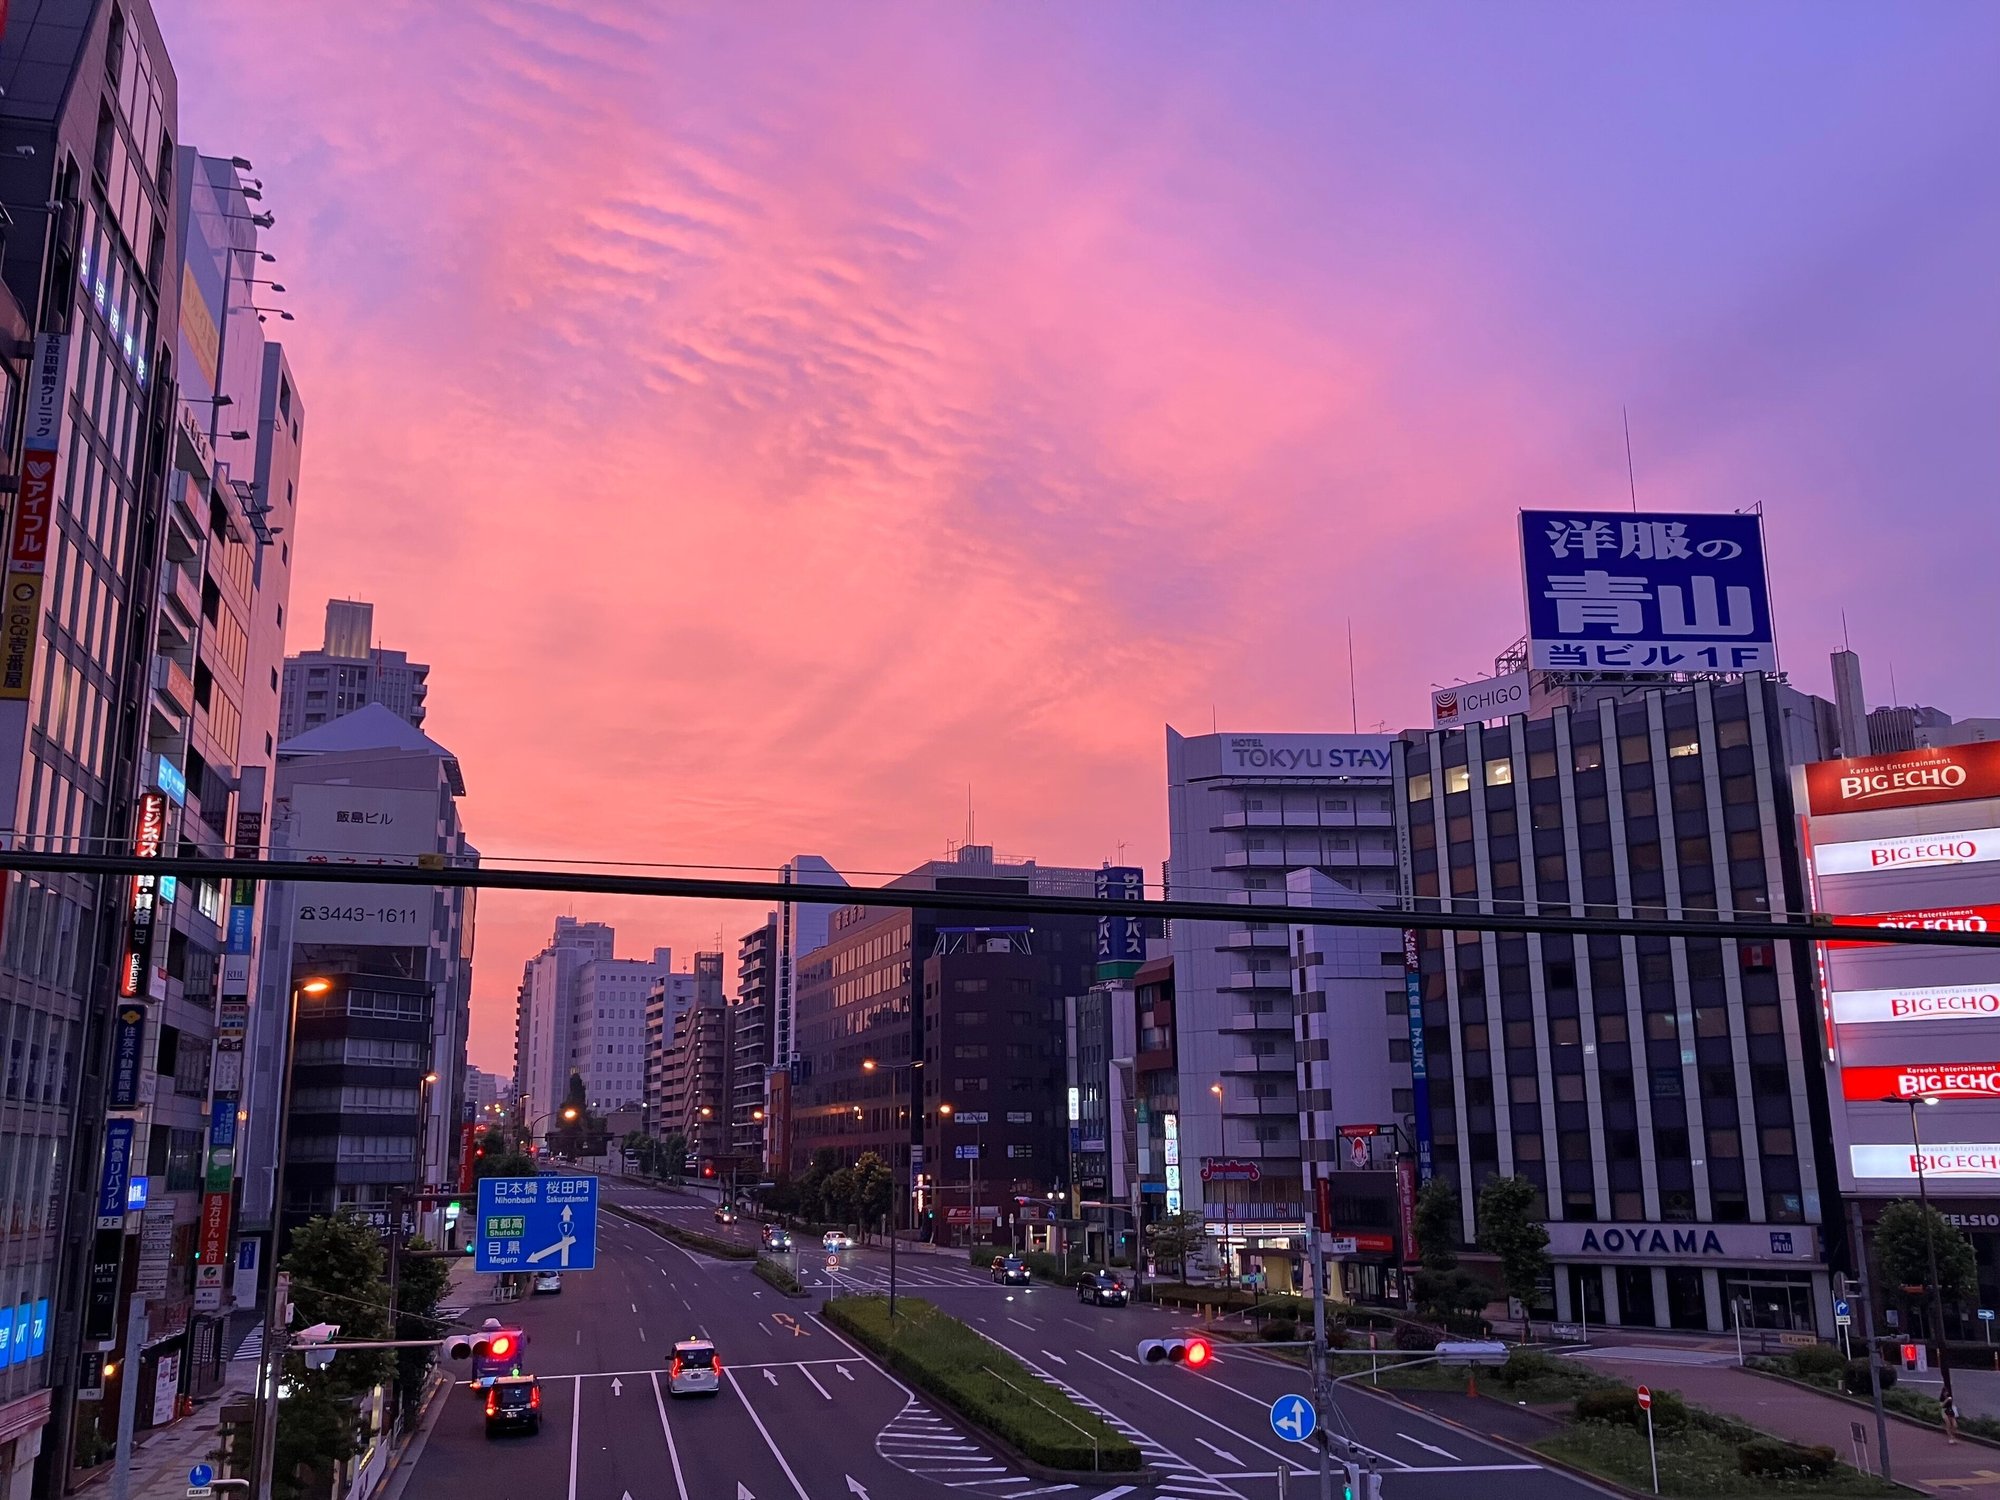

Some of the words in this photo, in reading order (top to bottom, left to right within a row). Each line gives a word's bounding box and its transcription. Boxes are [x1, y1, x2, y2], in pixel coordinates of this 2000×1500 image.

[37, 334, 61, 437] 五反田駅前クリニック
[19, 480, 47, 552] アイフル
[1545, 520, 1743, 560] 洋服の
[1544, 570, 1754, 636] 青山
[1463, 685, 1522, 712] ICHIGO
[1232, 739, 1263, 747] HOTEL
[1231, 749, 1322, 768] TOKYU
[1329, 749, 1391, 770] STAY
[1850, 765, 1885, 775] Karaoke
[1887, 757, 1952, 771] Entertainment
[1840, 774, 1889, 799] BIG
[1893, 765, 1967, 787] ECHO
[336, 811, 394, 825] 飯島ビル
[1871, 847, 1911, 867] BIG
[1915, 841, 1977, 858] ECHO
[318, 906, 417, 924] 3443-1611
[1123, 873, 1142, 954] サロパス
[1918, 909, 1974, 919] Entertainment
[1891, 998, 1932, 1017] BIG
[1937, 994, 2000, 1012] ECHO
[1940, 1065, 1997, 1073] Entertainment
[1898, 1075, 1942, 1095] BIG
[1910, 1155, 1952, 1173] BIG
[1957, 1155, 2000, 1168] ECH
[105, 1139, 125, 1210] 東急リバブル
[495, 1181, 538, 1196] 日本橋
[546, 1180, 590, 1194] 桜田門
[495, 1195, 537, 1204] Nihonbashi
[546, 1195, 589, 1203] Sakuradamon
[102, 1218, 119, 1227] 2F
[488, 1218, 523, 1230] 首都高
[563, 1223, 568, 1233] 1
[489, 1229, 521, 1237] Shutoko
[1581, 1228, 1724, 1254] AOYAMA
[488, 1240, 520, 1255] 目黒
[489, 1256, 518, 1265] Meguro
